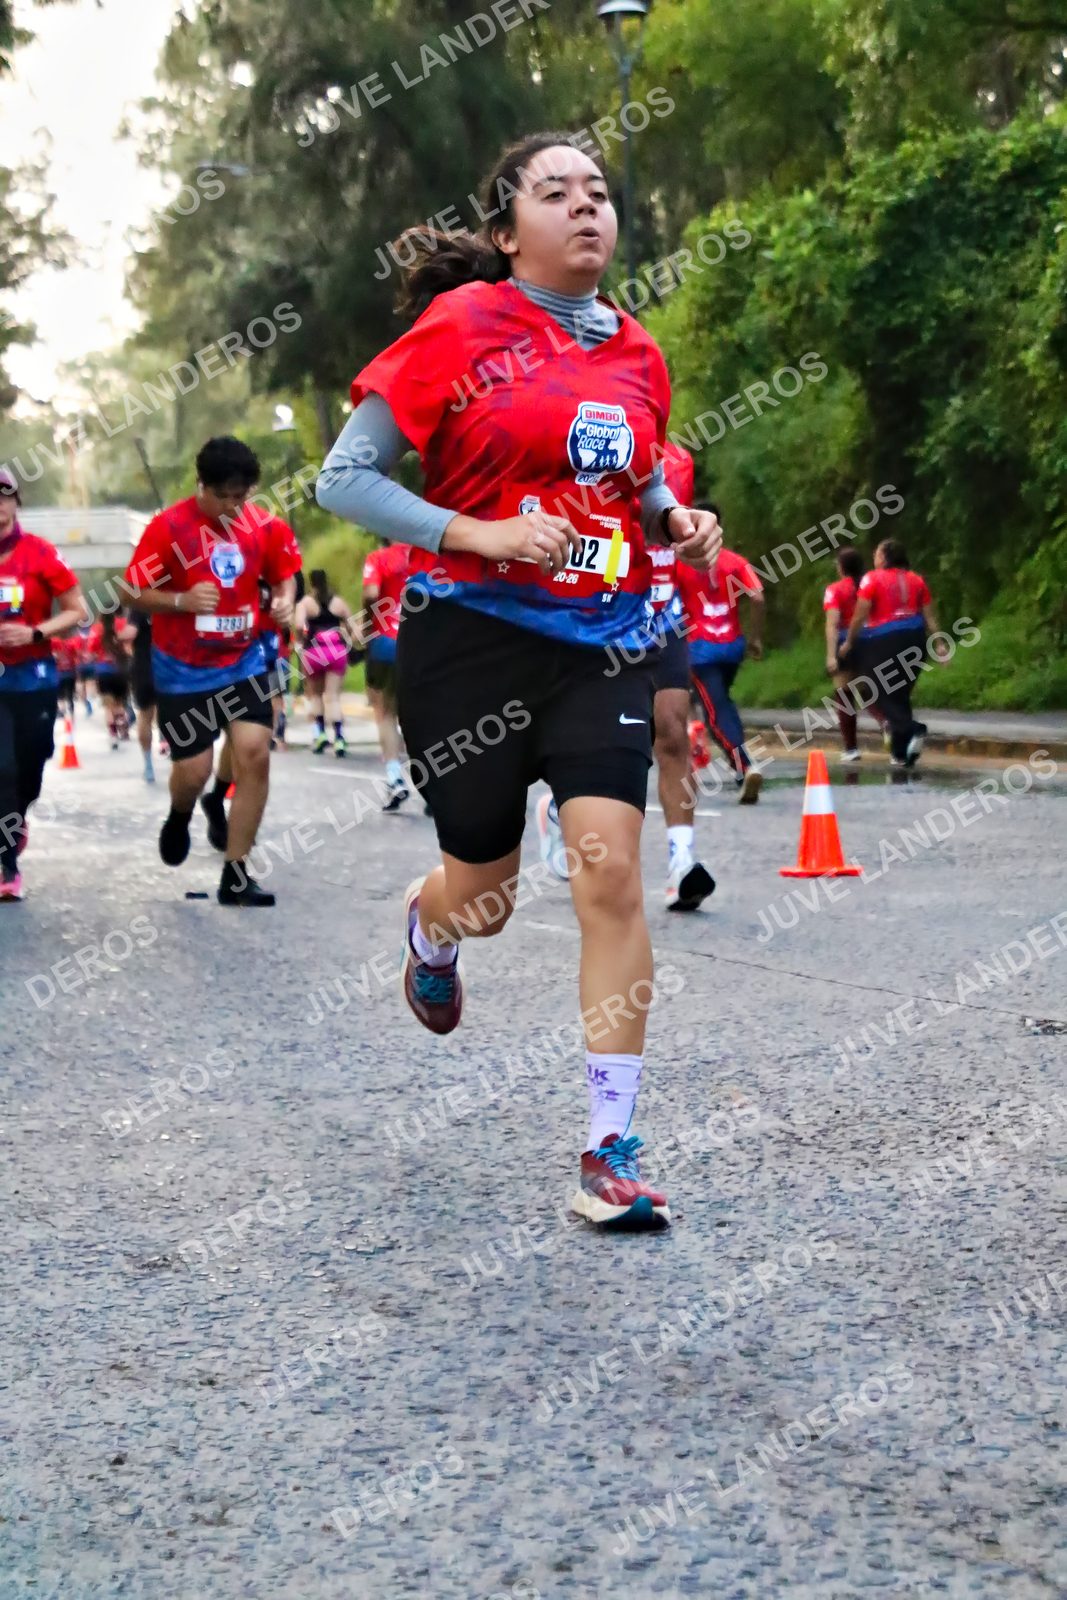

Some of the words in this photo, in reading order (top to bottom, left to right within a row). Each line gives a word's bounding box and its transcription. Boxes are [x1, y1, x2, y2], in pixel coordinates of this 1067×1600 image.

[585, 409, 620, 422] BIMBO
[586, 424, 621, 440] Global
[577, 435, 606, 450] Race
